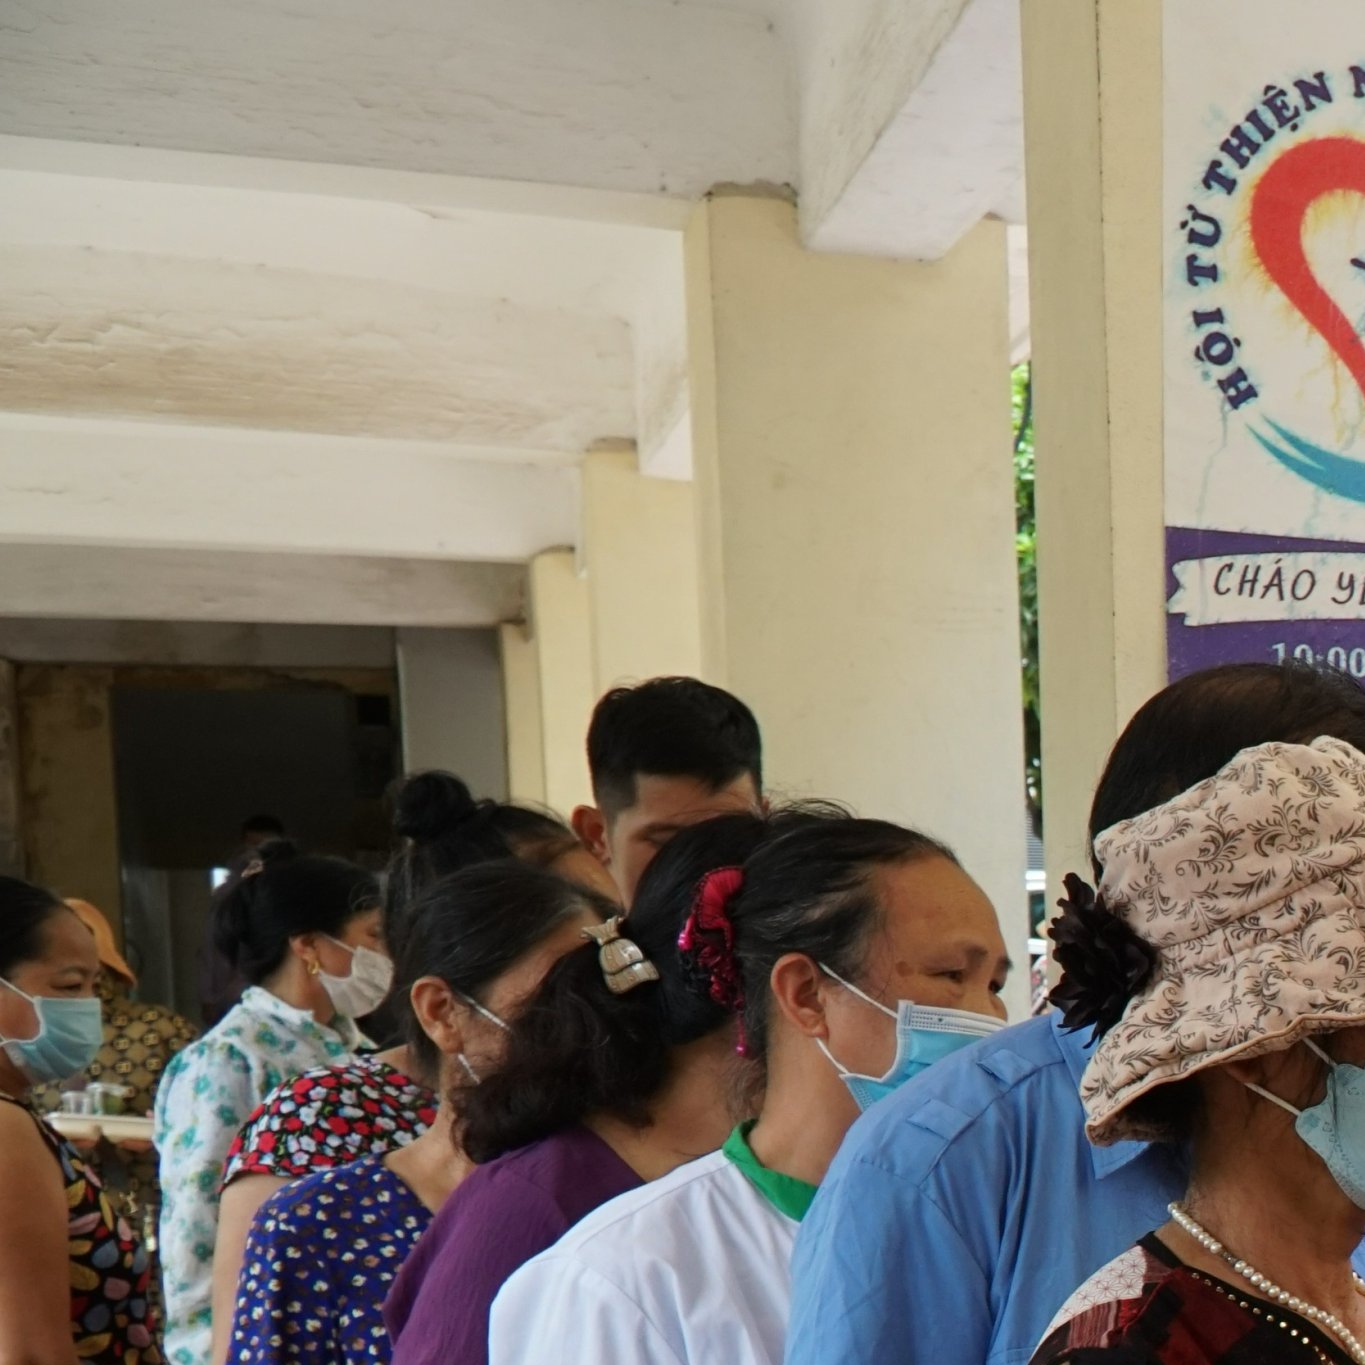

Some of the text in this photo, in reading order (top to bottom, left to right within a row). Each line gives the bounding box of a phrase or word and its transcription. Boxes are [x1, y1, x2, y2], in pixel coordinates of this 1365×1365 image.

[1201, 71, 1333, 196] THIỆN
[1179, 203, 1222, 287] TỪ
[1193, 307, 1259, 410] HỘI
[1213, 558, 1316, 602] CHÁO
